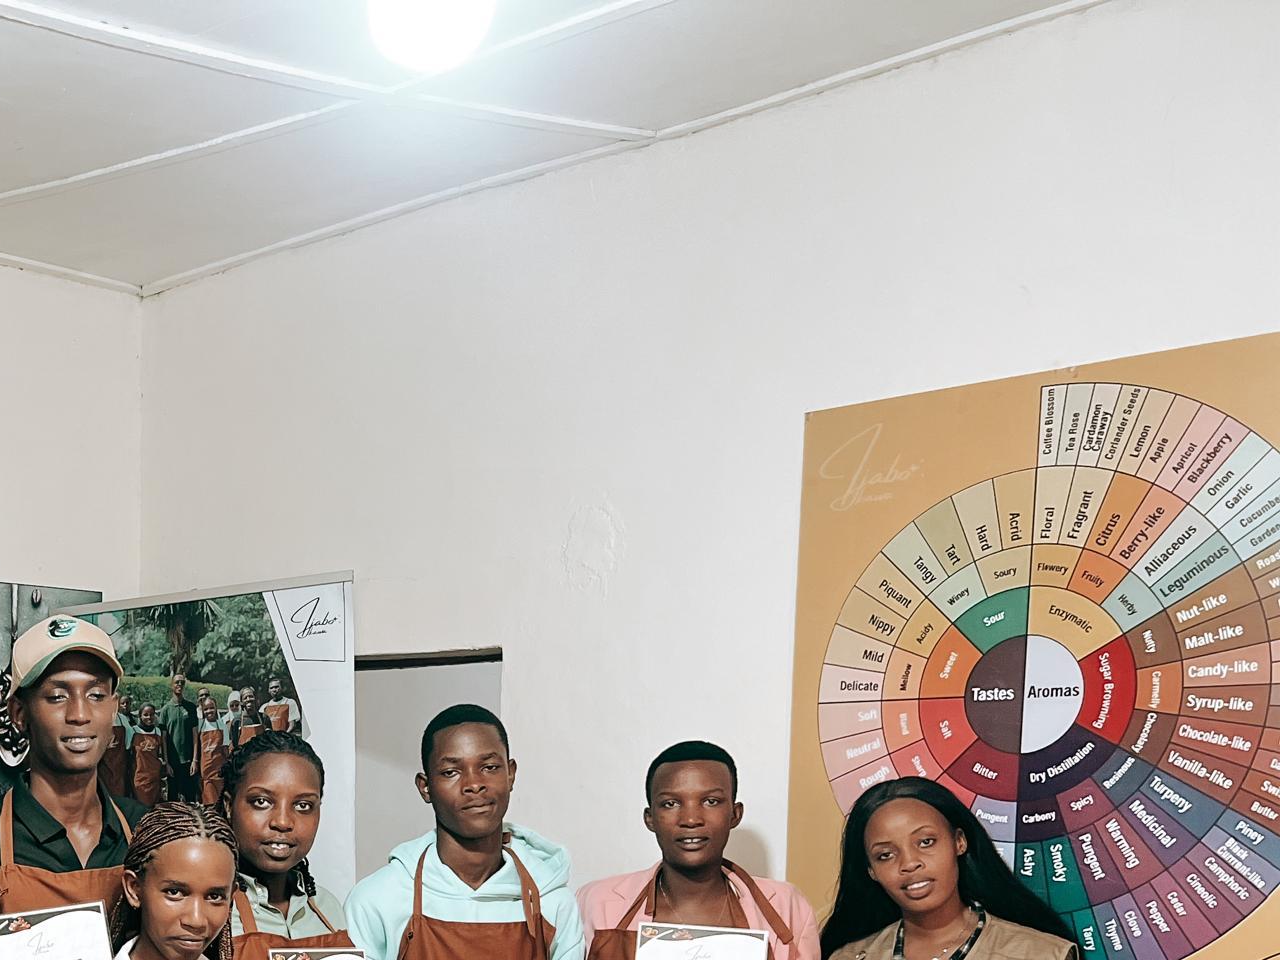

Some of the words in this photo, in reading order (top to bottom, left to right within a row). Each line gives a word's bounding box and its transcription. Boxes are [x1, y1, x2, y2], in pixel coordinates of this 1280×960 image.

[1047, 388, 1055, 421] Blossom
[1066, 439, 1074, 452] Tea
[1070, 412, 1080, 436] Rose
[1092, 411, 1112, 451] Caraway
[1105, 419, 1128, 460] Coriander
[1124, 388, 1141, 416] Seeds
[1043, 422, 1053, 455] Coffee
[1130, 425, 1151, 458] Lemon
[1150, 437, 1169, 463] Apple
[1172, 443, 1198, 474] Apricot
[1188, 433, 1233, 484] Blackberry
[1208, 470, 1235, 496] Onion
[1225, 482, 1253, 510] Garlic
[1009, 512, 1022, 541] Acrid
[1040, 507, 1055, 539] Floral
[1067, 490, 1094, 539] Fragrant
[975, 525, 992, 551] Hard
[1095, 513, 1121, 547] Citrus
[1120, 506, 1165, 560] Berry-like
[945, 544, 961, 566] Tart
[1143, 524, 1198, 577] Alliaceous
[914, 556, 937, 584] Tangy
[994, 567, 1018, 579] Soury
[1037, 563, 1069, 575] Flowery
[1081, 570, 1105, 588] Fruity
[1159, 545, 1229, 598] Leguminous
[879, 580, 912, 608] Piquant
[947, 587, 970, 606] Winey
[1118, 593, 1138, 616] Herby
[1176, 592, 1228, 623] Nut-like
[868, 614, 895, 636] Nippy
[983, 610, 1005, 627] Sour
[1048, 604, 1093, 634] Enzymatic
[916, 623, 934, 644] Acidy
[1142, 629, 1156, 654] Nutty
[1184, 625, 1244, 651] Malt-like
[862, 650, 884, 663] Mild
[939, 652, 958, 680] Sweet
[1098, 652, 1110, 681] Sugar
[1188, 661, 1258, 679] Candy-like
[840, 680, 879, 691] Delicate
[900, 663, 912, 691] Mellow
[971, 688, 1015, 701] Tastes
[1028, 685, 1080, 698] Aromas
[1093, 682, 1114, 729] Browning
[1186, 695, 1254, 712] Syrup-like
[857, 709, 877, 722] Soft
[899, 712, 910, 736] Bland
[939, 720, 952, 739] Salt
[846, 739, 881, 759] Neutral
[1178, 724, 1252, 752] Chocolate-like
[911, 755, 927, 778] Sharp
[972, 762, 998, 780] Bitter
[1030, 772, 1046, 784] Dry
[1047, 741, 1095, 777] Distillation
[1103, 756, 1136, 790] Resinous
[1168, 750, 1233, 790] Vanilla-like
[859, 766, 890, 789] Rough
[1070, 794, 1094, 812] Spicy
[1149, 776, 1193, 814] Turpeny
[975, 809, 1008, 824] Pungent
[1022, 811, 1056, 823] Carbony
[1128, 799, 1177, 848] Medicinal
[1250, 801, 1279, 820] Butter
[1105, 818, 1140, 869] Warming
[1235, 821, 1265, 845] Piney
[1020, 848, 1035, 877] Ashy
[1050, 843, 1067, 882] Smoky
[1078, 833, 1106, 881] Pungent
[1224, 838, 1249, 859] Black
[1186, 873, 1218, 909] Cineolic
[1204, 857, 1251, 901] Camphoric
[1146, 901, 1171, 933] Pepper
[1167, 891, 1187, 917] Cedar
[1105, 918, 1123, 951] Thyme
[1124, 910, 1142, 938] Clove
[1082, 926, 1096, 951] Tarry
